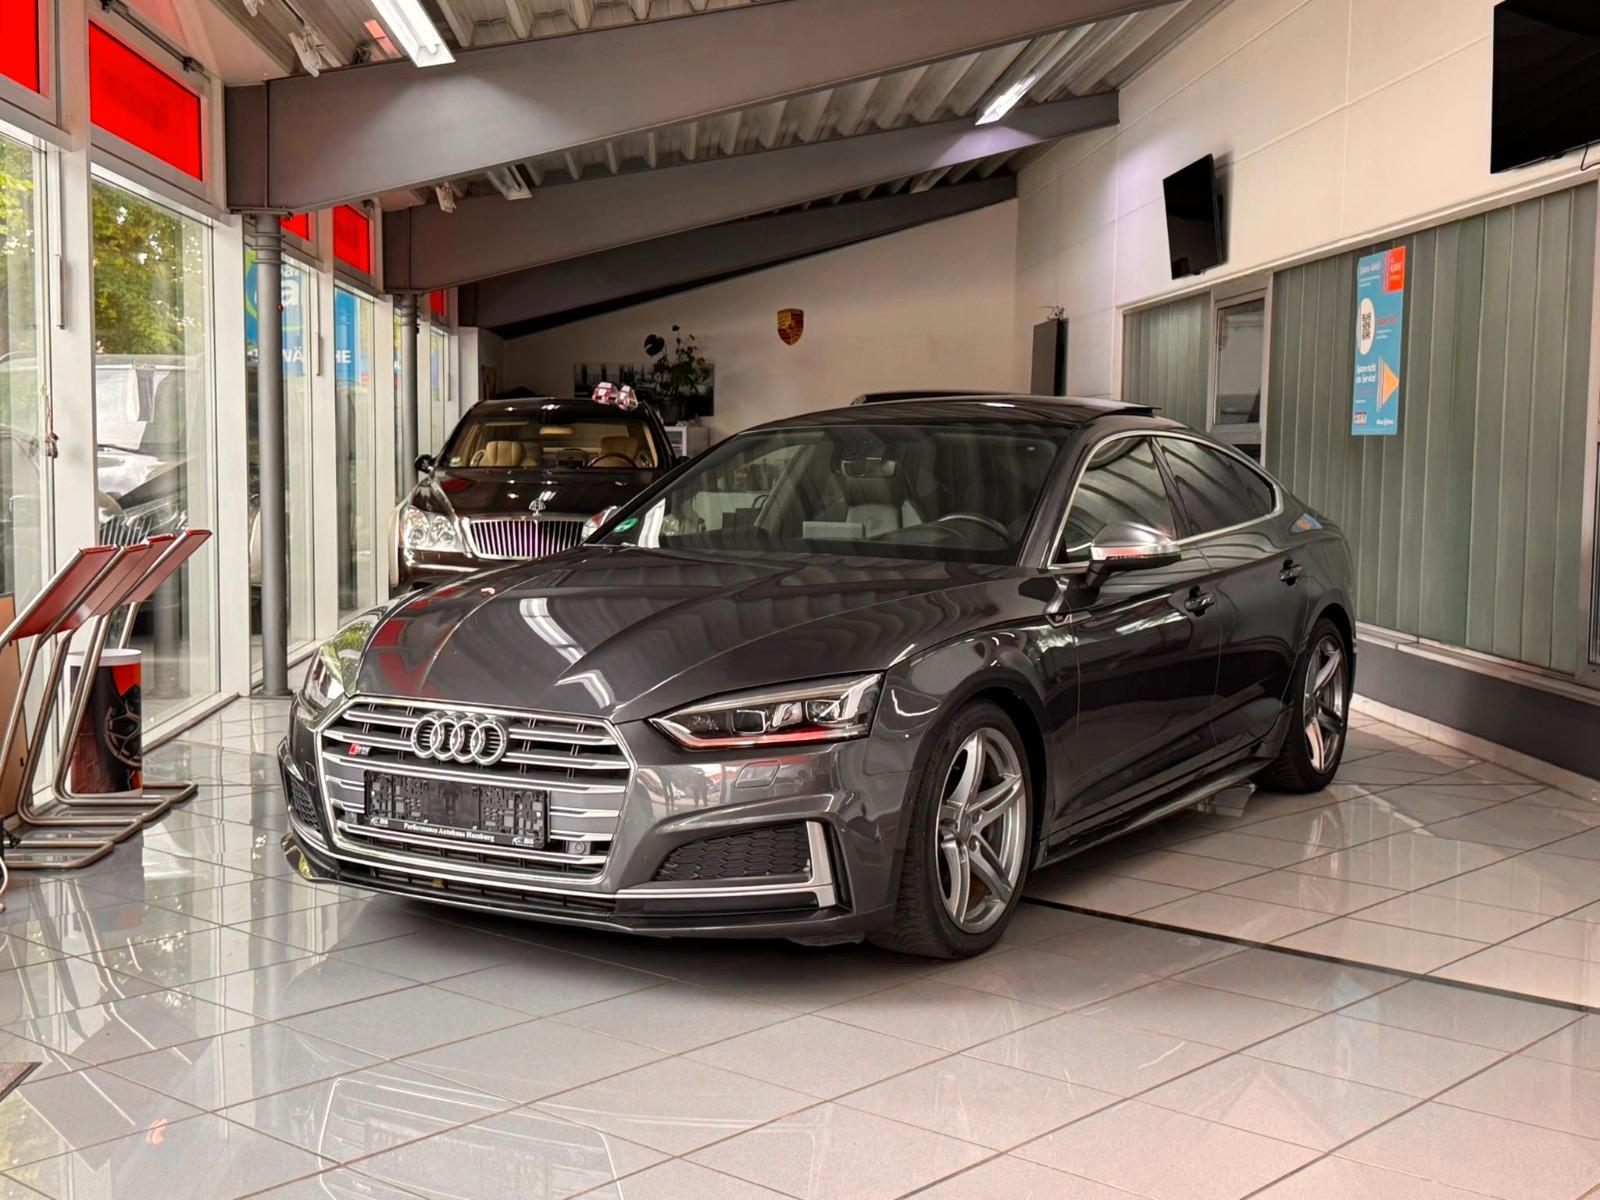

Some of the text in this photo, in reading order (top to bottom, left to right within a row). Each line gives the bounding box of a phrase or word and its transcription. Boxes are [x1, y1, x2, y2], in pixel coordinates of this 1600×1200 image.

[403, 822, 495, 842] Performance Autohaus Hamburg
